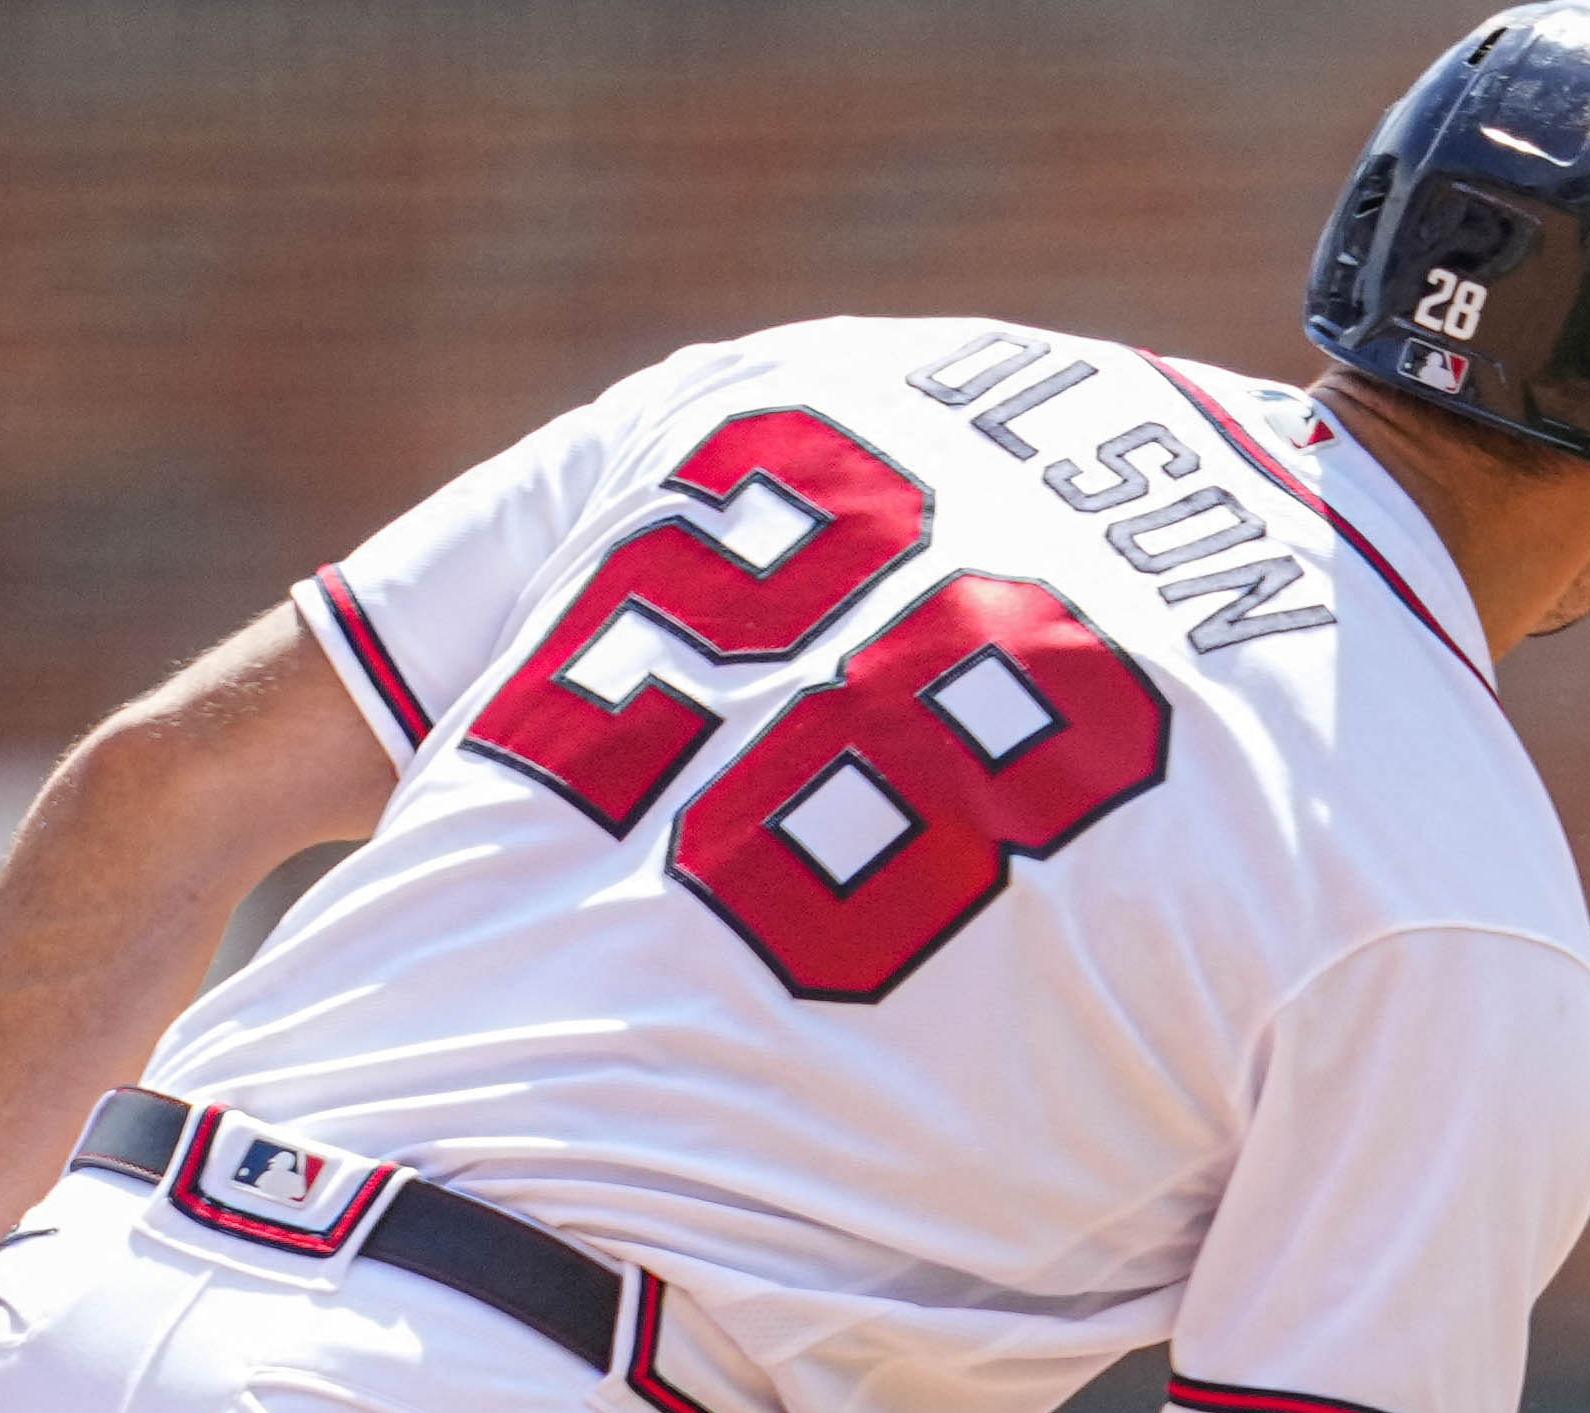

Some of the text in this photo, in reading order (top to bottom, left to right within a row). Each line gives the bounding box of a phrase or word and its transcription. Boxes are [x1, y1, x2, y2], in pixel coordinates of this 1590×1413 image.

[1415, 268, 1487, 341] 28
[906, 330, 1338, 654] OLSON
[458, 404, 1173, 1004] 28
